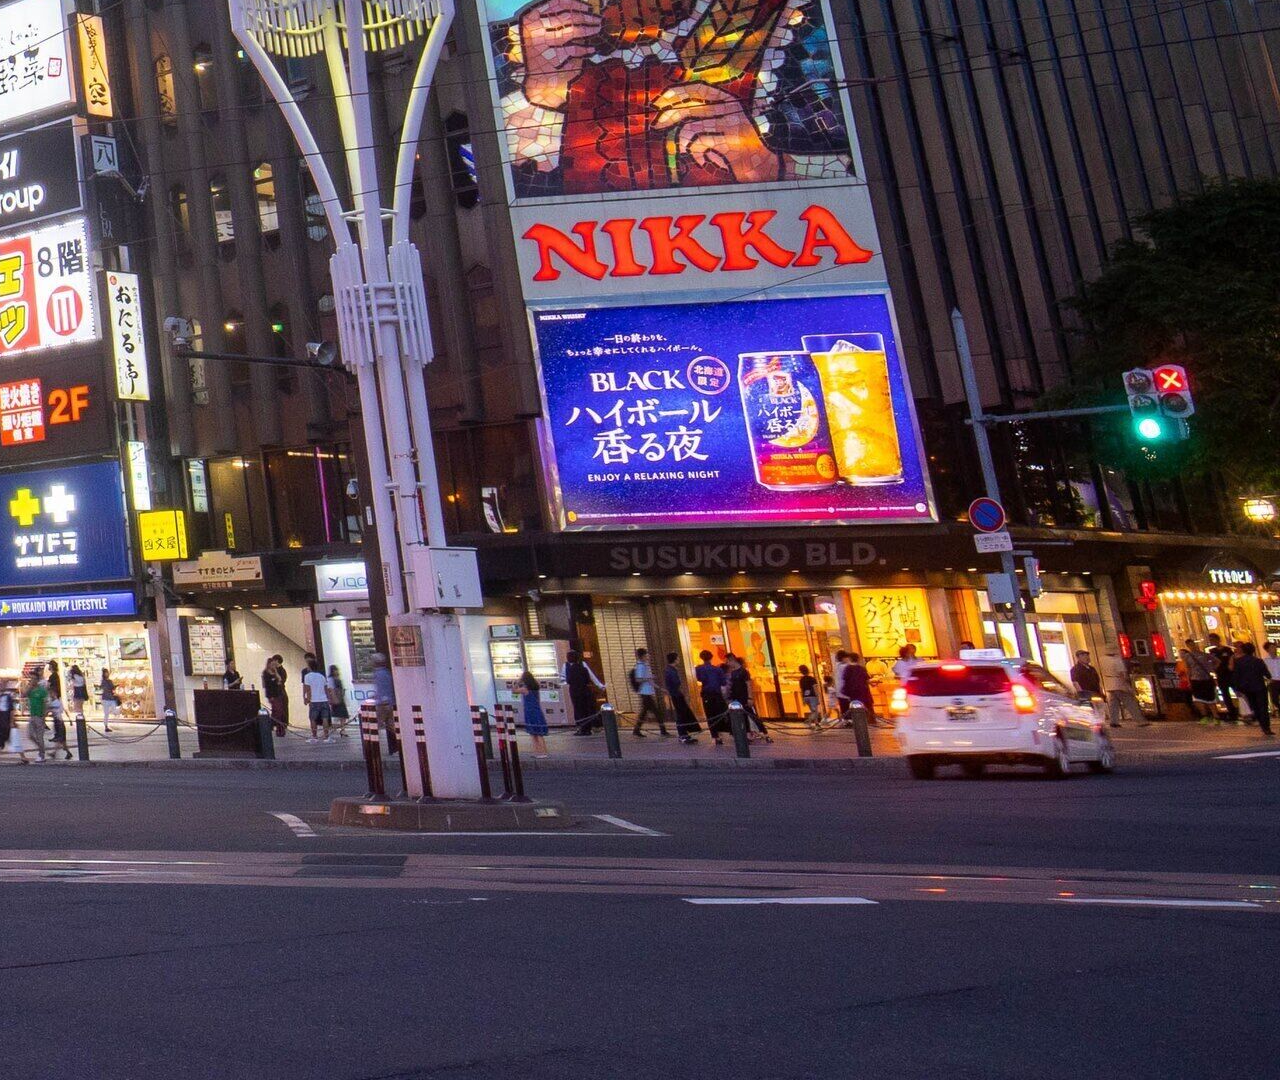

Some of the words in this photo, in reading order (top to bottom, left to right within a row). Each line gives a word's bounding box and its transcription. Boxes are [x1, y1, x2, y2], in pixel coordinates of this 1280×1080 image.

[522, 204, 874, 283] NIKKA
[37, 240, 85, 278] 8階
[566, 345, 703, 357] ちょっと幸せにしてくれるハイボール。
[604, 333, 668, 345] 一日の終わりを、
[590, 370, 686, 393] BLACK
[694, 366, 725, 377] 北海道
[696, 376, 720, 388] 限定
[0, 382, 41, 410] 炭火焼き
[47, 385, 90, 425] 2F
[565, 397, 722, 427] ハイボール
[592, 426, 709, 465] 香る夜
[588, 472, 620, 482] ENJOY
[634, 471, 685, 481] RELAXING
[688, 470, 721, 480] NIGHT
[15, 531, 78, 555] サツドラ
[144, 536, 176, 551] 四文屋
[610, 543, 790, 572] SUSUKINO
[806, 541, 887, 567] BLD.
[196, 565, 236, 576] すすきのビル
[12, 600, 46, 613] HOKKAIDO
[48, 599, 70, 612] HAPPY
[71, 598, 107, 611] LIFESTYLE
[897, 595, 920, 628] 札幌
[861, 595, 881, 650] スクエア
[879, 595, 904, 650] タイムズ
[351, 689, 376, 701] IQO
